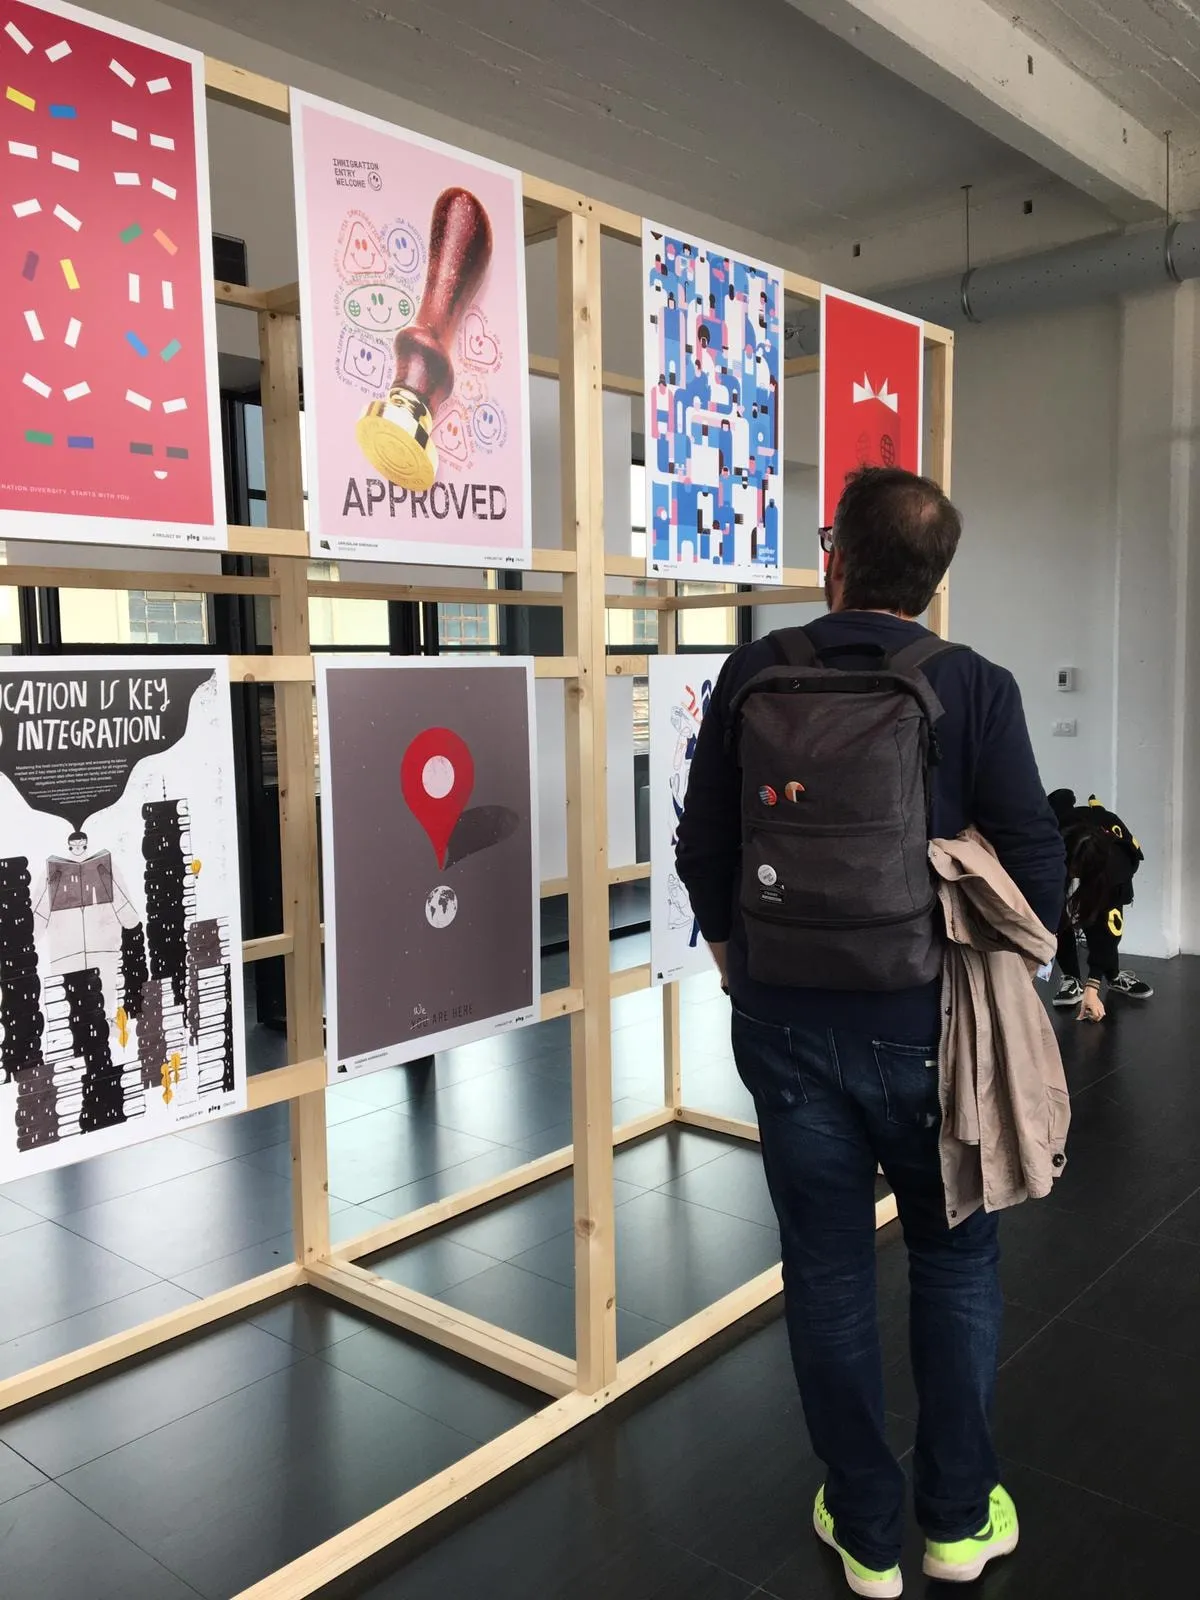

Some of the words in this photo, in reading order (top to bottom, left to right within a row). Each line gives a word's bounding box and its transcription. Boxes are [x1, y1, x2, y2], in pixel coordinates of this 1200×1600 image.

[332, 158, 380, 170] IMMIGRATION
[334, 168, 356, 177] ENTRY
[335, 178, 367, 188] WELCOME
[342, 477, 507, 520] APPROVED
[0, 680, 87, 714] CATION
[100, 679, 120, 710] IS
[129, 677, 170, 712] KEY
[17, 715, 166, 751] INTEGRATION.
